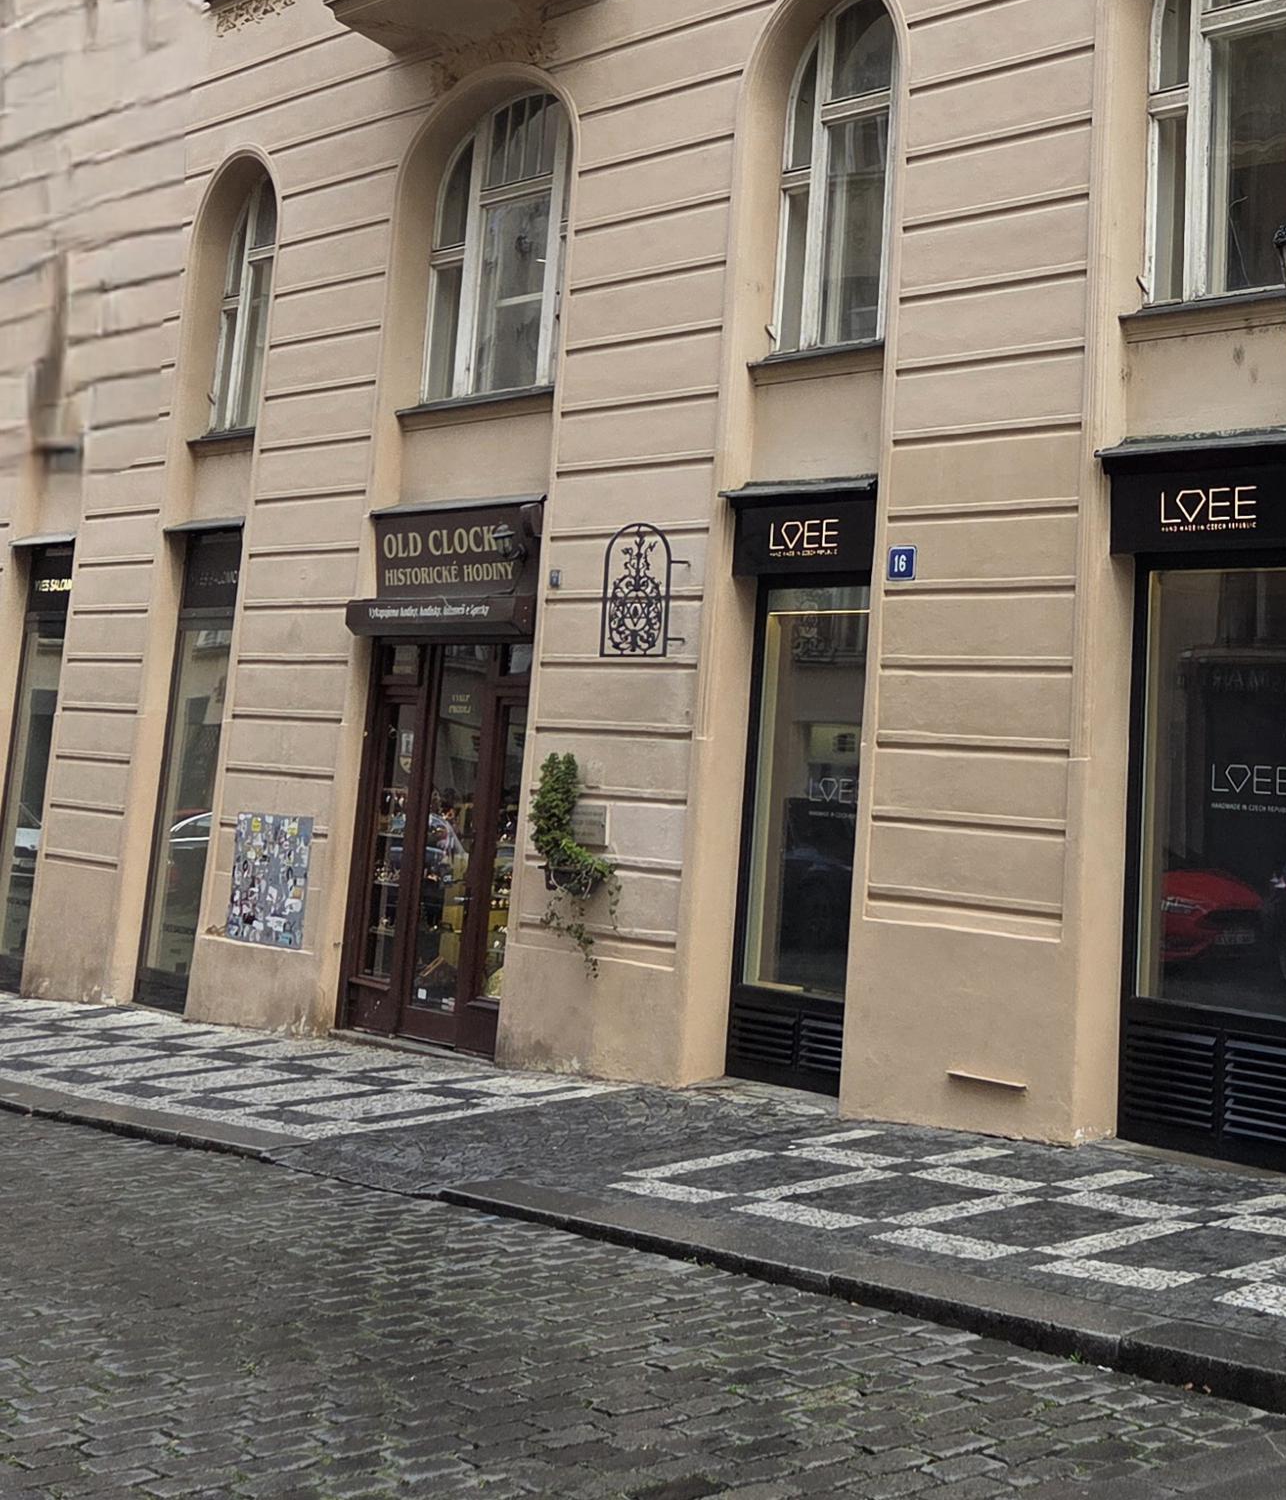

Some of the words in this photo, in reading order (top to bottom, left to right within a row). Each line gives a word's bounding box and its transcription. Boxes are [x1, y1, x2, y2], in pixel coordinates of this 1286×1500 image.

[383, 532, 422, 558] OLD
[428, 525, 500, 556] CLOCK
[385, 561, 459, 586] HISTORICKÉ
[463, 561, 515, 582] HODINY
[894, 554, 907, 572] 16
[808, 778, 853, 804] LOE
